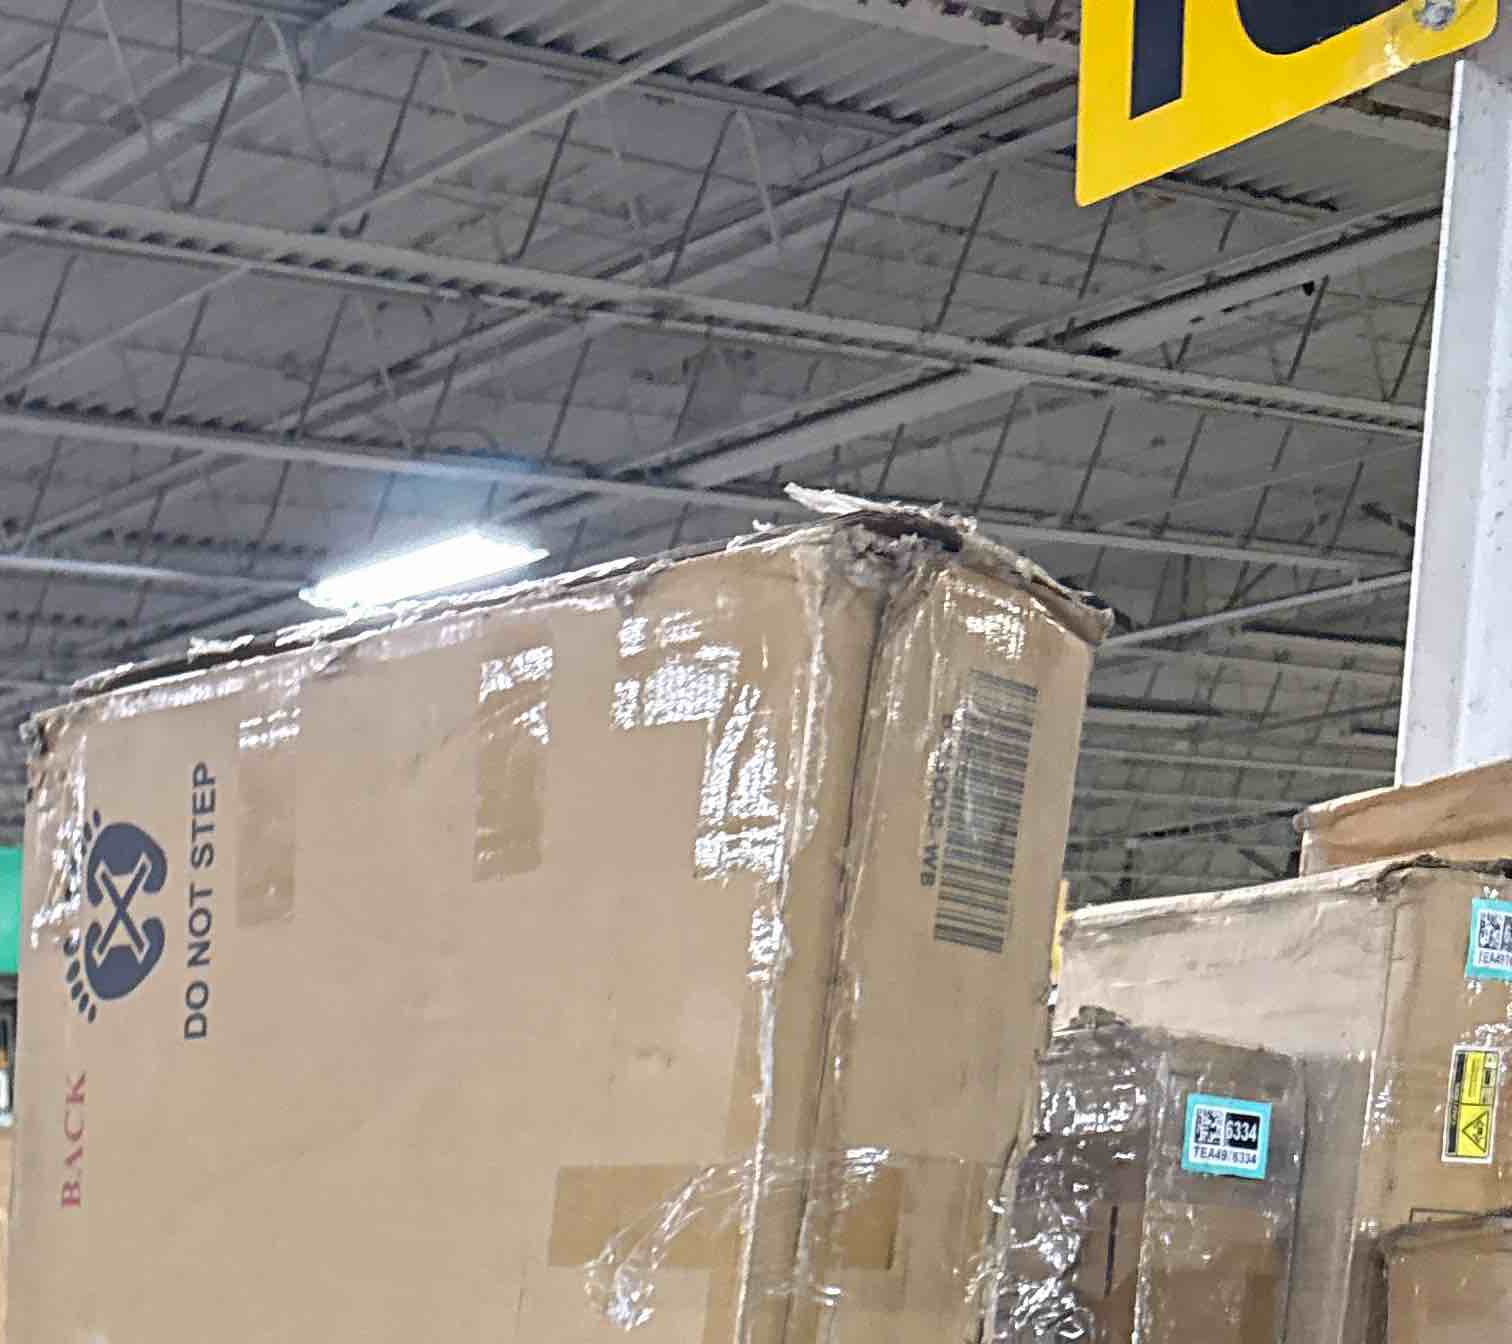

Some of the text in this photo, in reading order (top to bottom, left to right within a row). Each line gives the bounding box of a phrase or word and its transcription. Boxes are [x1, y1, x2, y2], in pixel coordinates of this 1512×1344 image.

[184, 761, 217, 1040] DO NOT STEP
[61, 1072, 87, 1208] BACK
[1224, 1120, 1257, 1143] 6334
